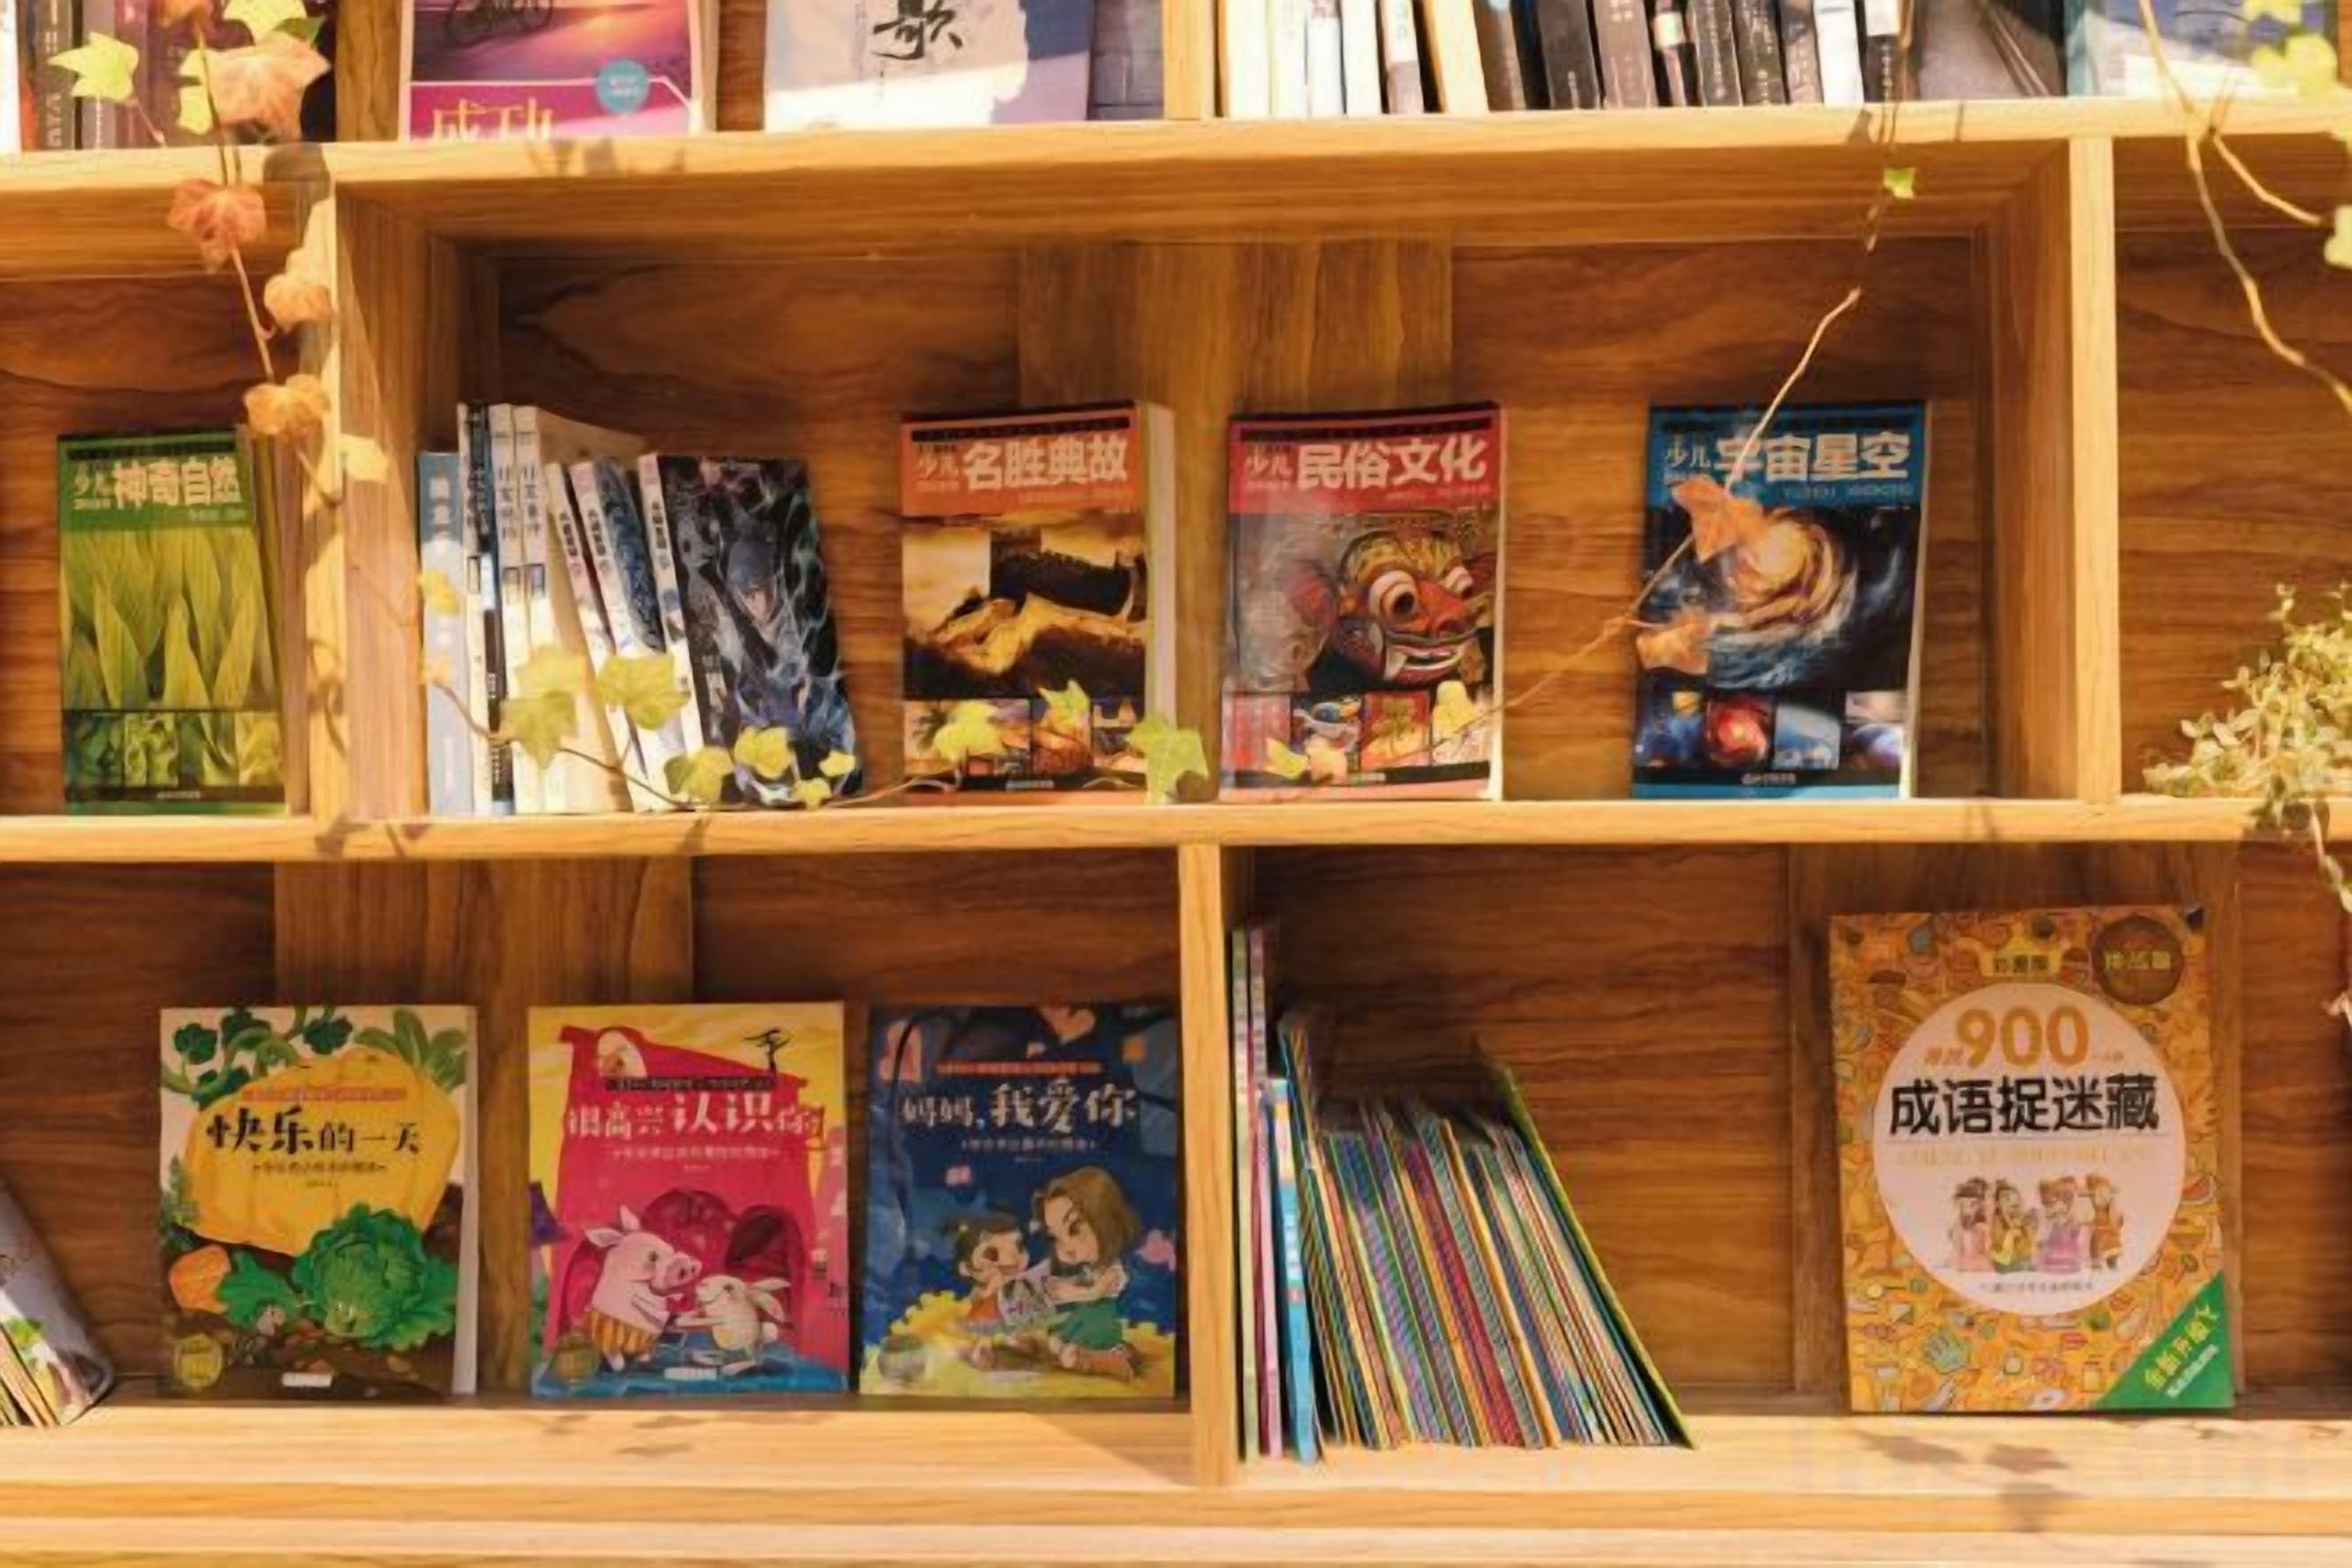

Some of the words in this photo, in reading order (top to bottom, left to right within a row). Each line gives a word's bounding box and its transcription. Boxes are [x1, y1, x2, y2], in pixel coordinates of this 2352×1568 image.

[112, 455, 242, 510] 神奇自然
[963, 434, 1128, 492] 名胜典故
[1297, 435, 1488, 490] 民俗文化
[1714, 431, 1911, 484] 宇宙星空
[1956, 1004, 2089, 1069] 900
[206, 1104, 422, 1156] 快乐的一天
[1889, 1072, 2160, 1136] 成语捉迷藏
